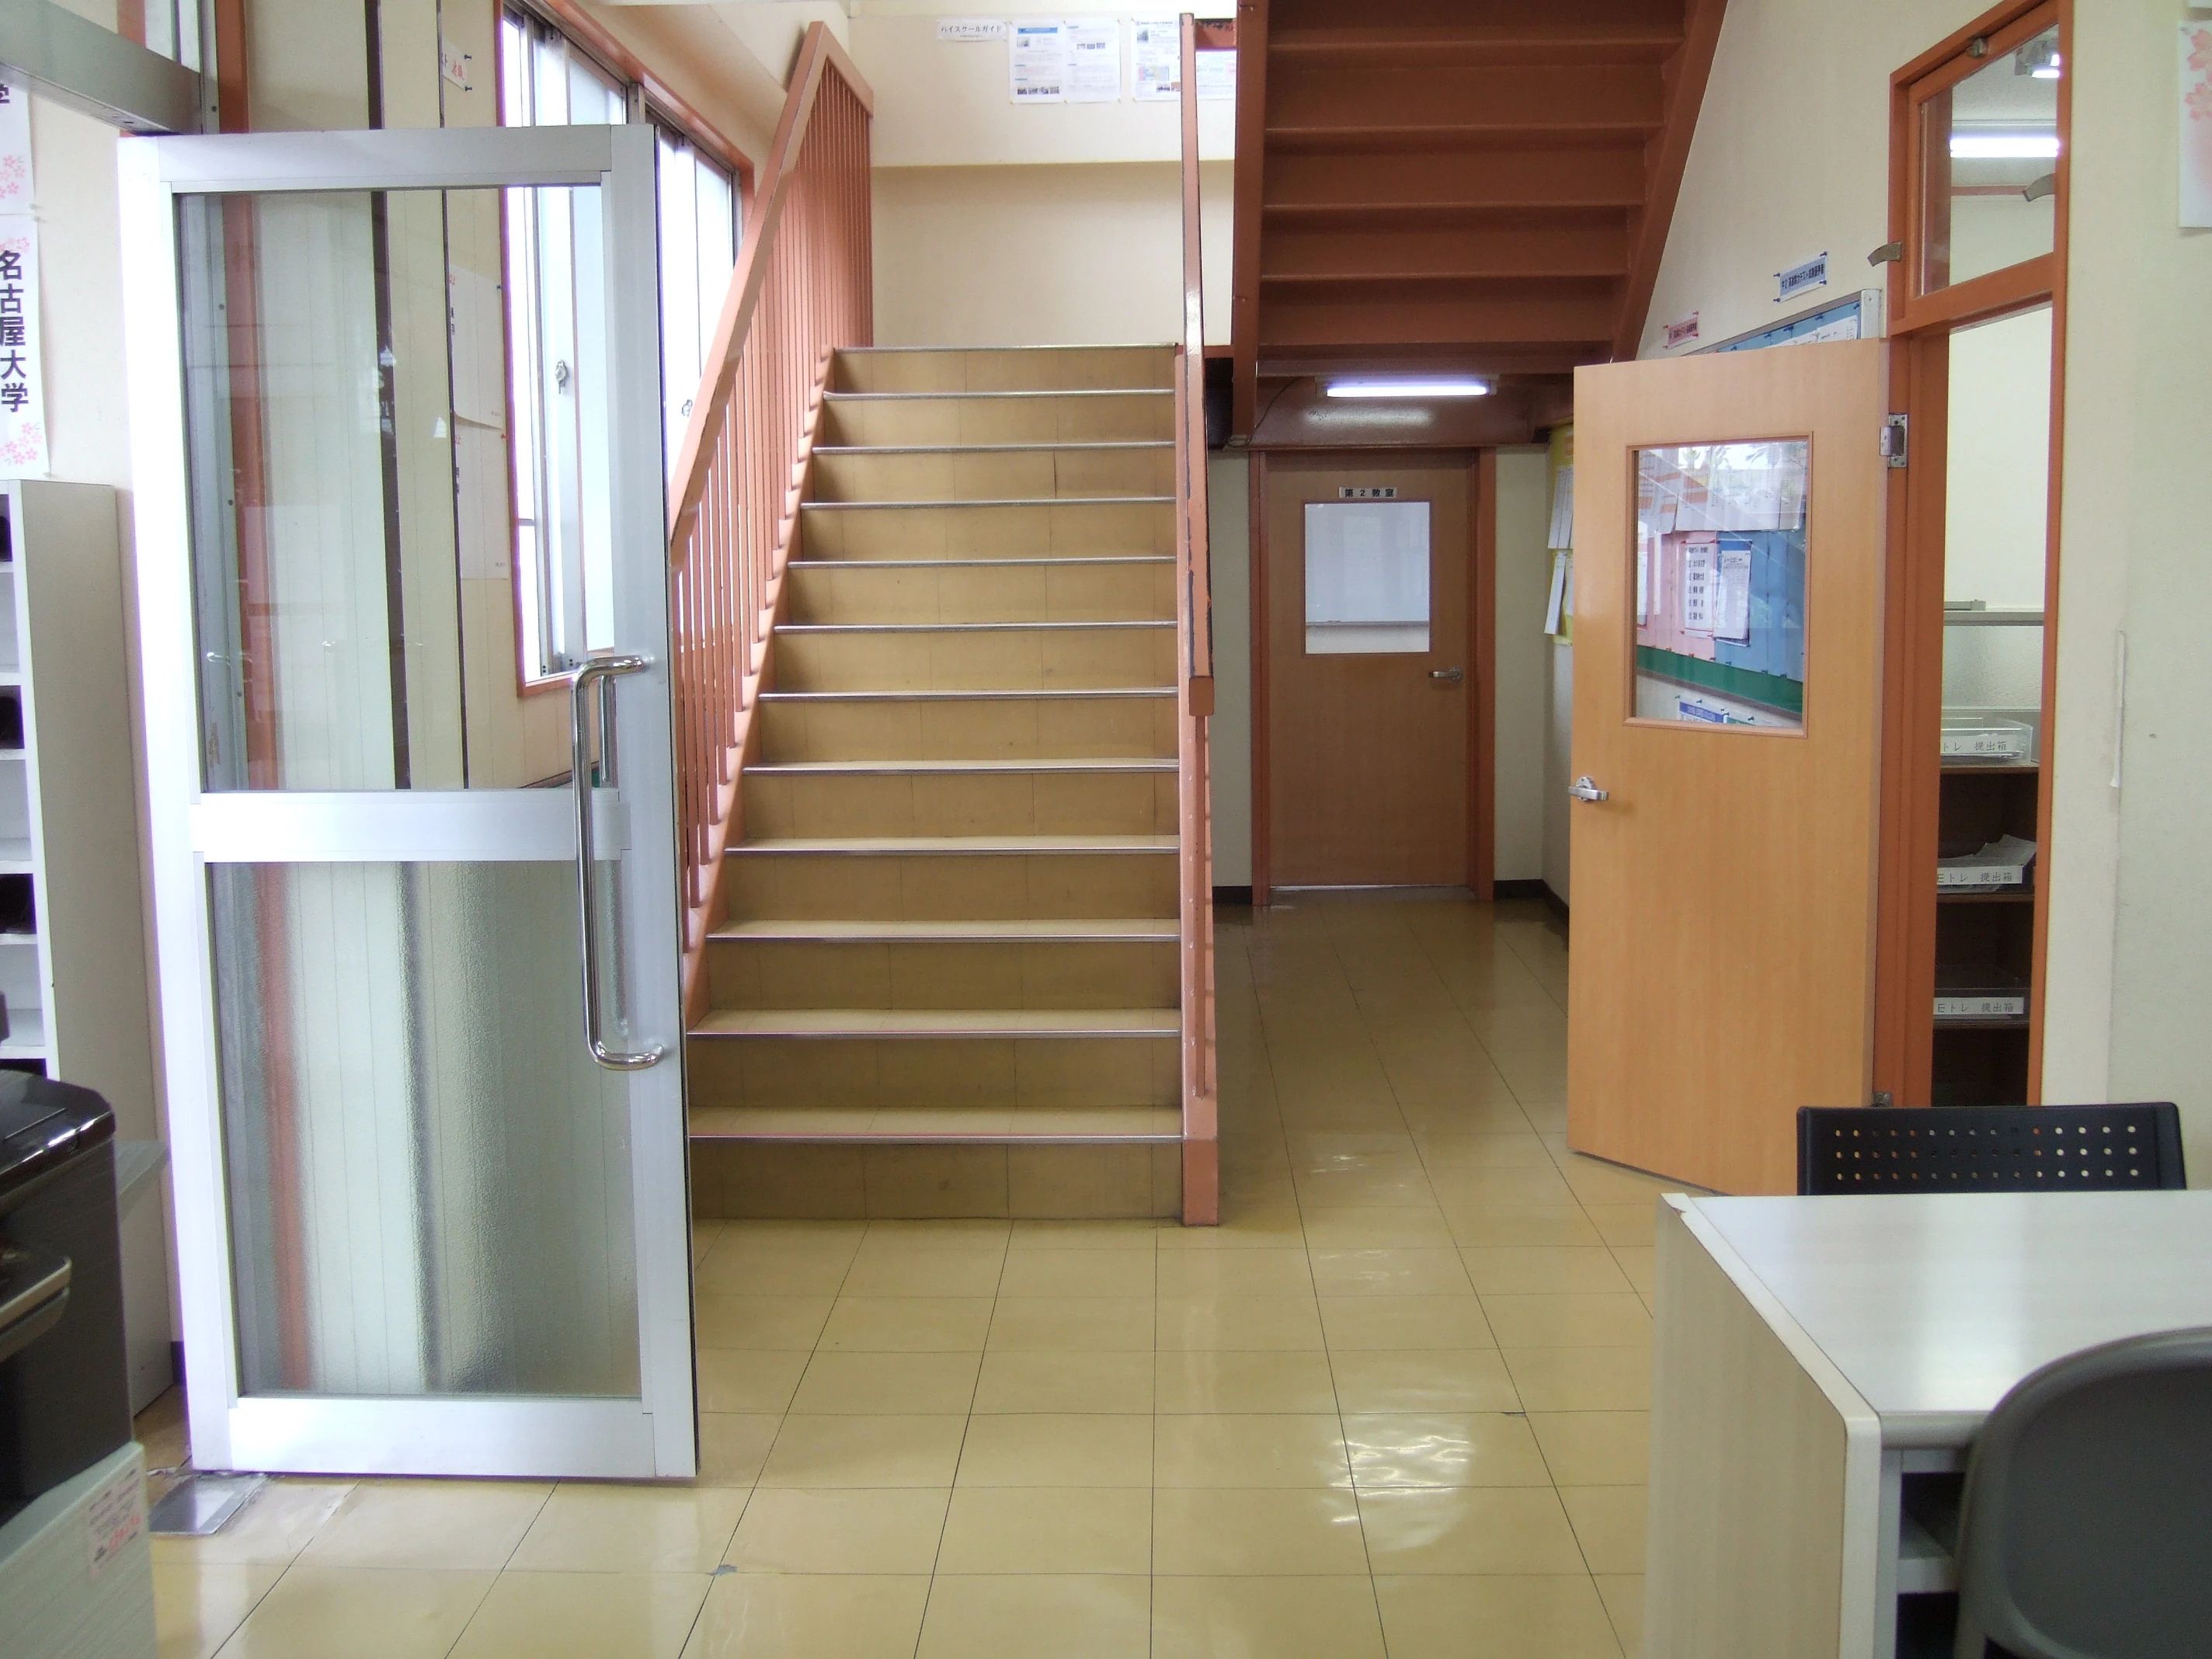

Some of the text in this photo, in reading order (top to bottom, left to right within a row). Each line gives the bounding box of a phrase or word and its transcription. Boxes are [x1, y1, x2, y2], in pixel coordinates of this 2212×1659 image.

[0, 250, 29, 412] 名古屋大学
